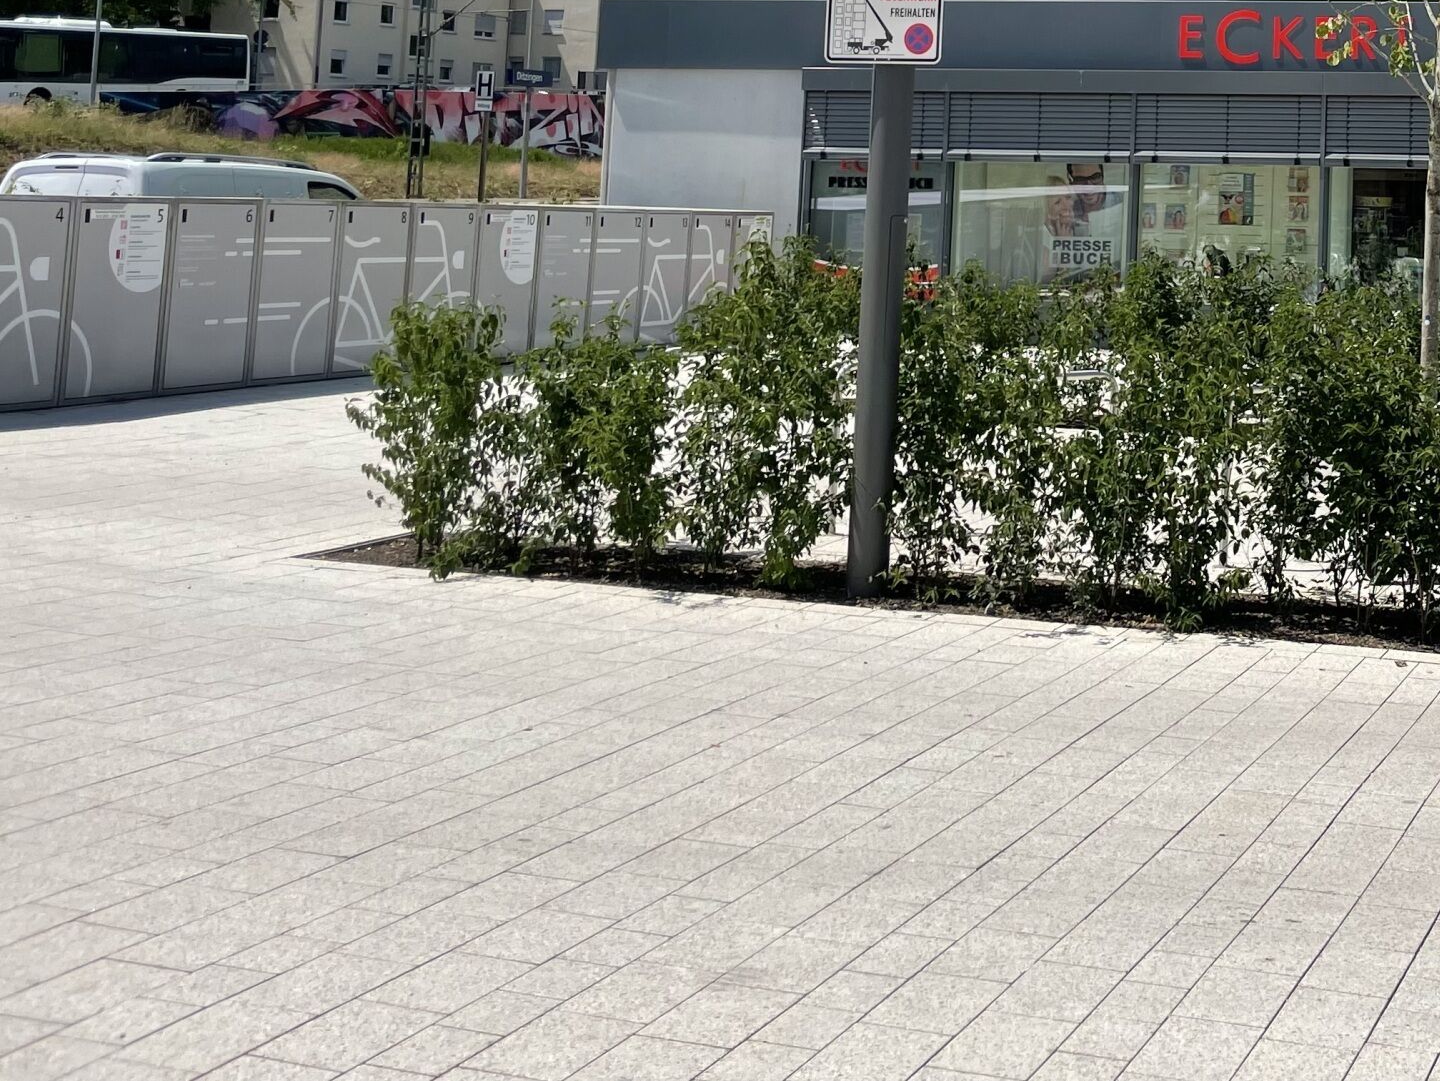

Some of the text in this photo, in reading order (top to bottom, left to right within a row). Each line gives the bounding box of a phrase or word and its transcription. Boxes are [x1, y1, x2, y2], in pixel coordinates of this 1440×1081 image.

[890, 7, 936, 18] FREIHALTEN
[478, 73, 493, 97] H
[55, 207, 64, 223] 4
[157, 208, 164, 223] 5
[246, 209, 253, 223] 6
[328, 209, 335, 223] 7
[401, 211, 408, 224] 8
[468, 212, 474, 224] 9
[526, 214, 535, 226] 10
[585, 215, 592, 227] 11
[634, 217, 642, 228] 12
[682, 217, 688, 228] 13
[1052, 239, 1112, 252] PRESSE
[1060, 252, 1111, 265] BUCH
